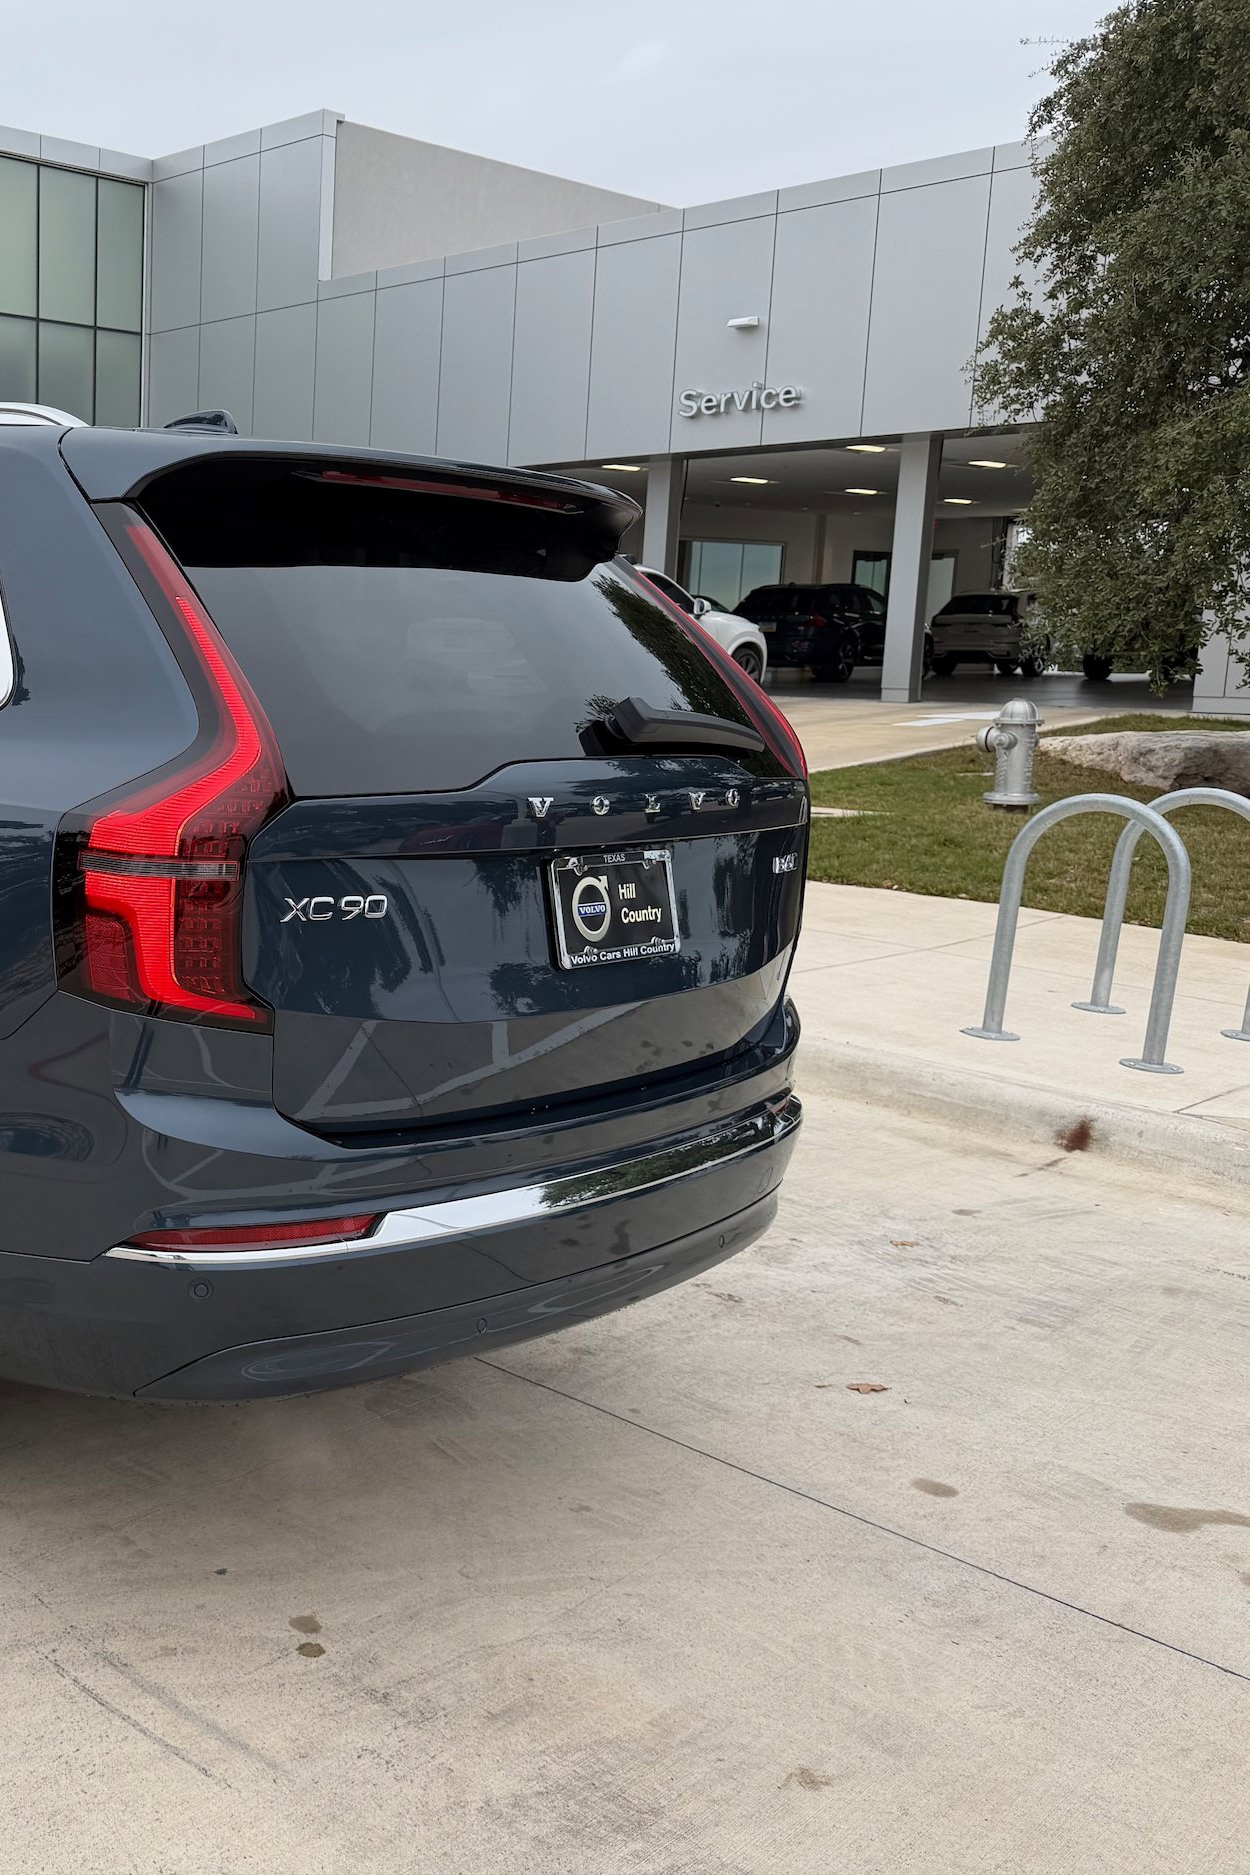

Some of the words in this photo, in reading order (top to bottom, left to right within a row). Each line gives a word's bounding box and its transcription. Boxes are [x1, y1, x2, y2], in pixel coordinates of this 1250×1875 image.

[678, 381, 798, 417] Service
[528, 788, 740, 818] VOLVO
[603, 853, 626, 864] TEXAS
[618, 883, 636, 900] Hill
[578, 904, 606, 915] VOLVO
[621, 905, 662, 924] Country
[571, 953, 598, 965] Volvo
[599, 951, 621, 961] Cars
[623, 947, 639, 957] Hill
[640, 943, 675, 955] Country
